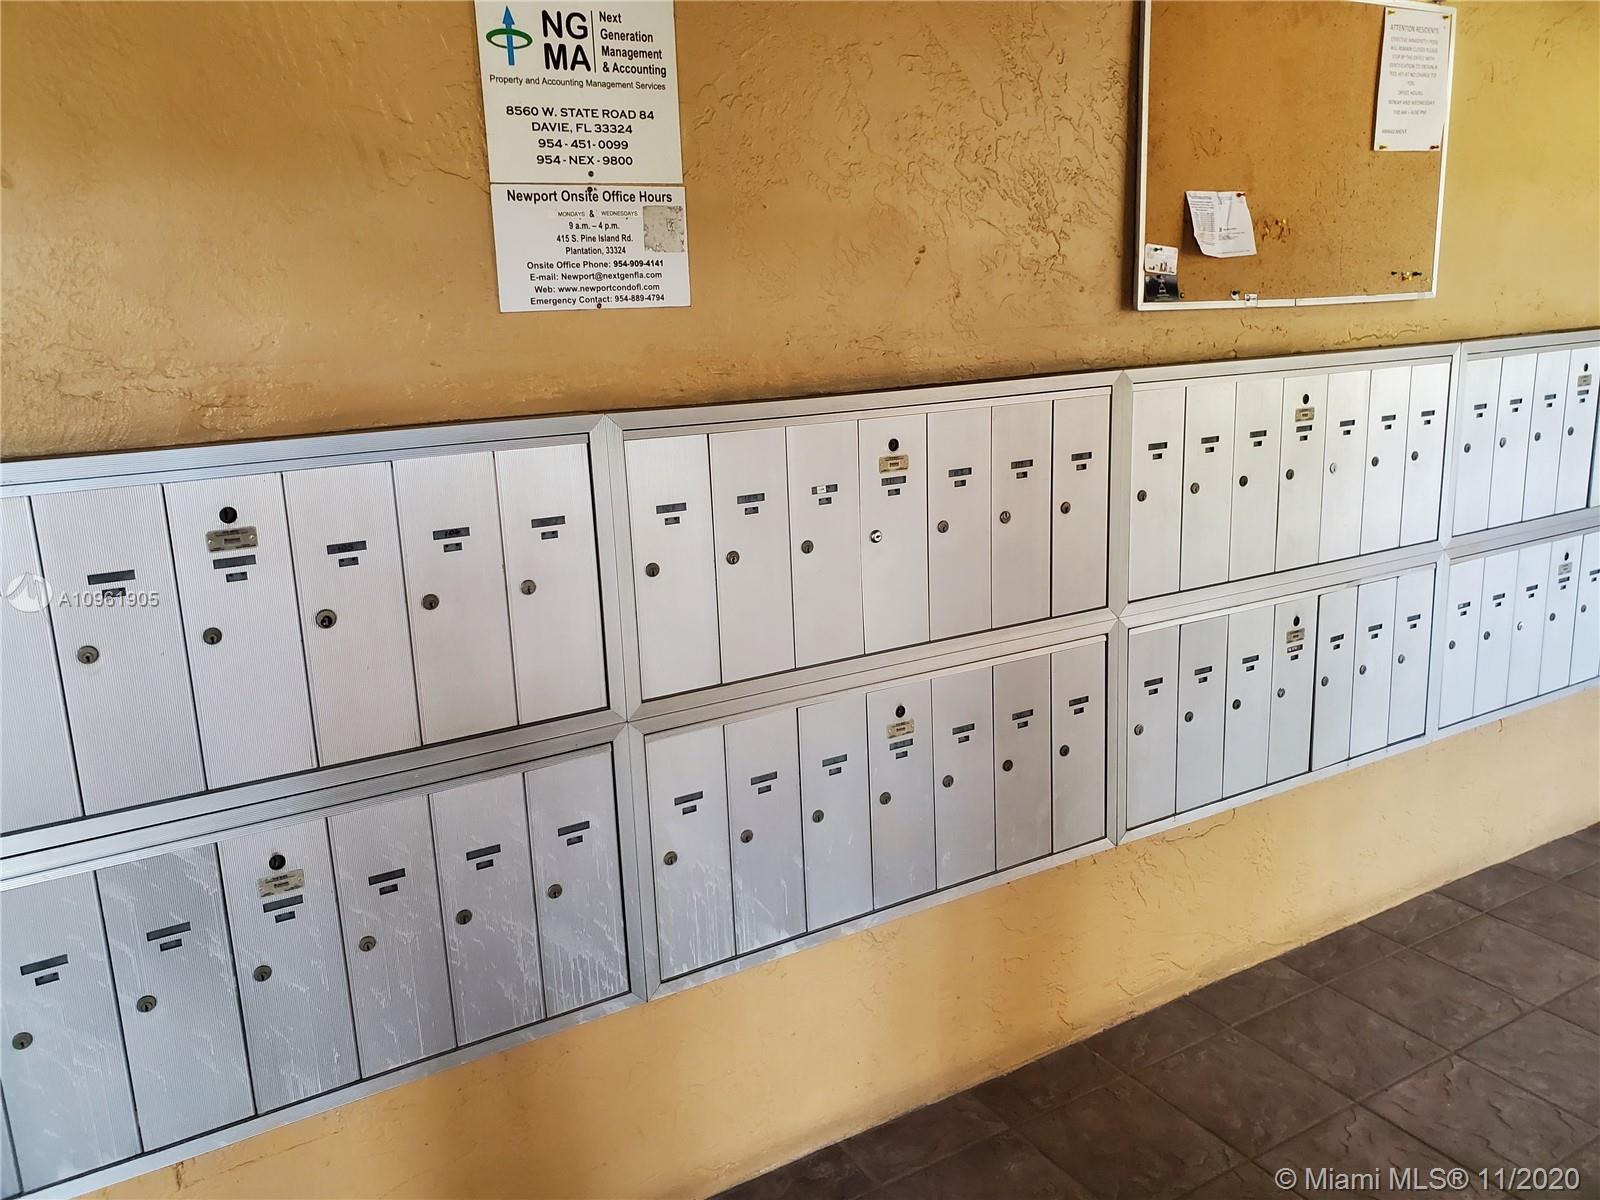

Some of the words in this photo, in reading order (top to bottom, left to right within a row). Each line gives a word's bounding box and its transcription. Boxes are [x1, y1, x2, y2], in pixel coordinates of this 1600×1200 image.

[599, 11, 621, 23] Next
[542, 9, 588, 39] NG
[600, 29, 653, 43] Generation
[544, 43, 591, 71] MA
[601, 46, 662, 60] Management
[603, 62, 610, 72] &
[612, 63, 666, 78] Accounting
[489, 75, 523, 86] Property
[525, 77, 540, 85] and
[542, 77, 583, 88] Accounting
[586, 79, 633, 90] Management
[635, 81, 666, 90] Services
[506, 106, 539, 116] 8560
[541, 107, 557, 117] W.
[560, 108, 599, 118] STATE
[602, 110, 637, 119] ROAD
[639, 111, 654, 120] 84
[531, 122, 573, 133] DAVIE,
[576, 123, 591, 133] FL
[594, 124, 632, 134] 33324
[507, 189, 558, 204] Newport
[561, 190, 598, 202] Onsite
[602, 191, 637, 203] Office
[639, 192, 672, 203] Hours
[589, 210, 595, 218] &
[605, 223, 620, 231] p.m.
[557, 235, 570, 243] 415
[572, 235, 578, 243] S.
[566, 247, 604, 256] Plantation,
[527, 262, 554, 270] Onsite
[557, 261, 580, 269] Office
[613, 260, 664, 268] 954-909-4141
[561, 272, 662, 281] Newport@nextgenfla.com
[558, 284, 660, 293] www.newportcondofl.com
[530, 297, 576, 306] Emergency
[579, 296, 613, 304] Contact:
[615, 294, 664, 303] 954-889-4794
